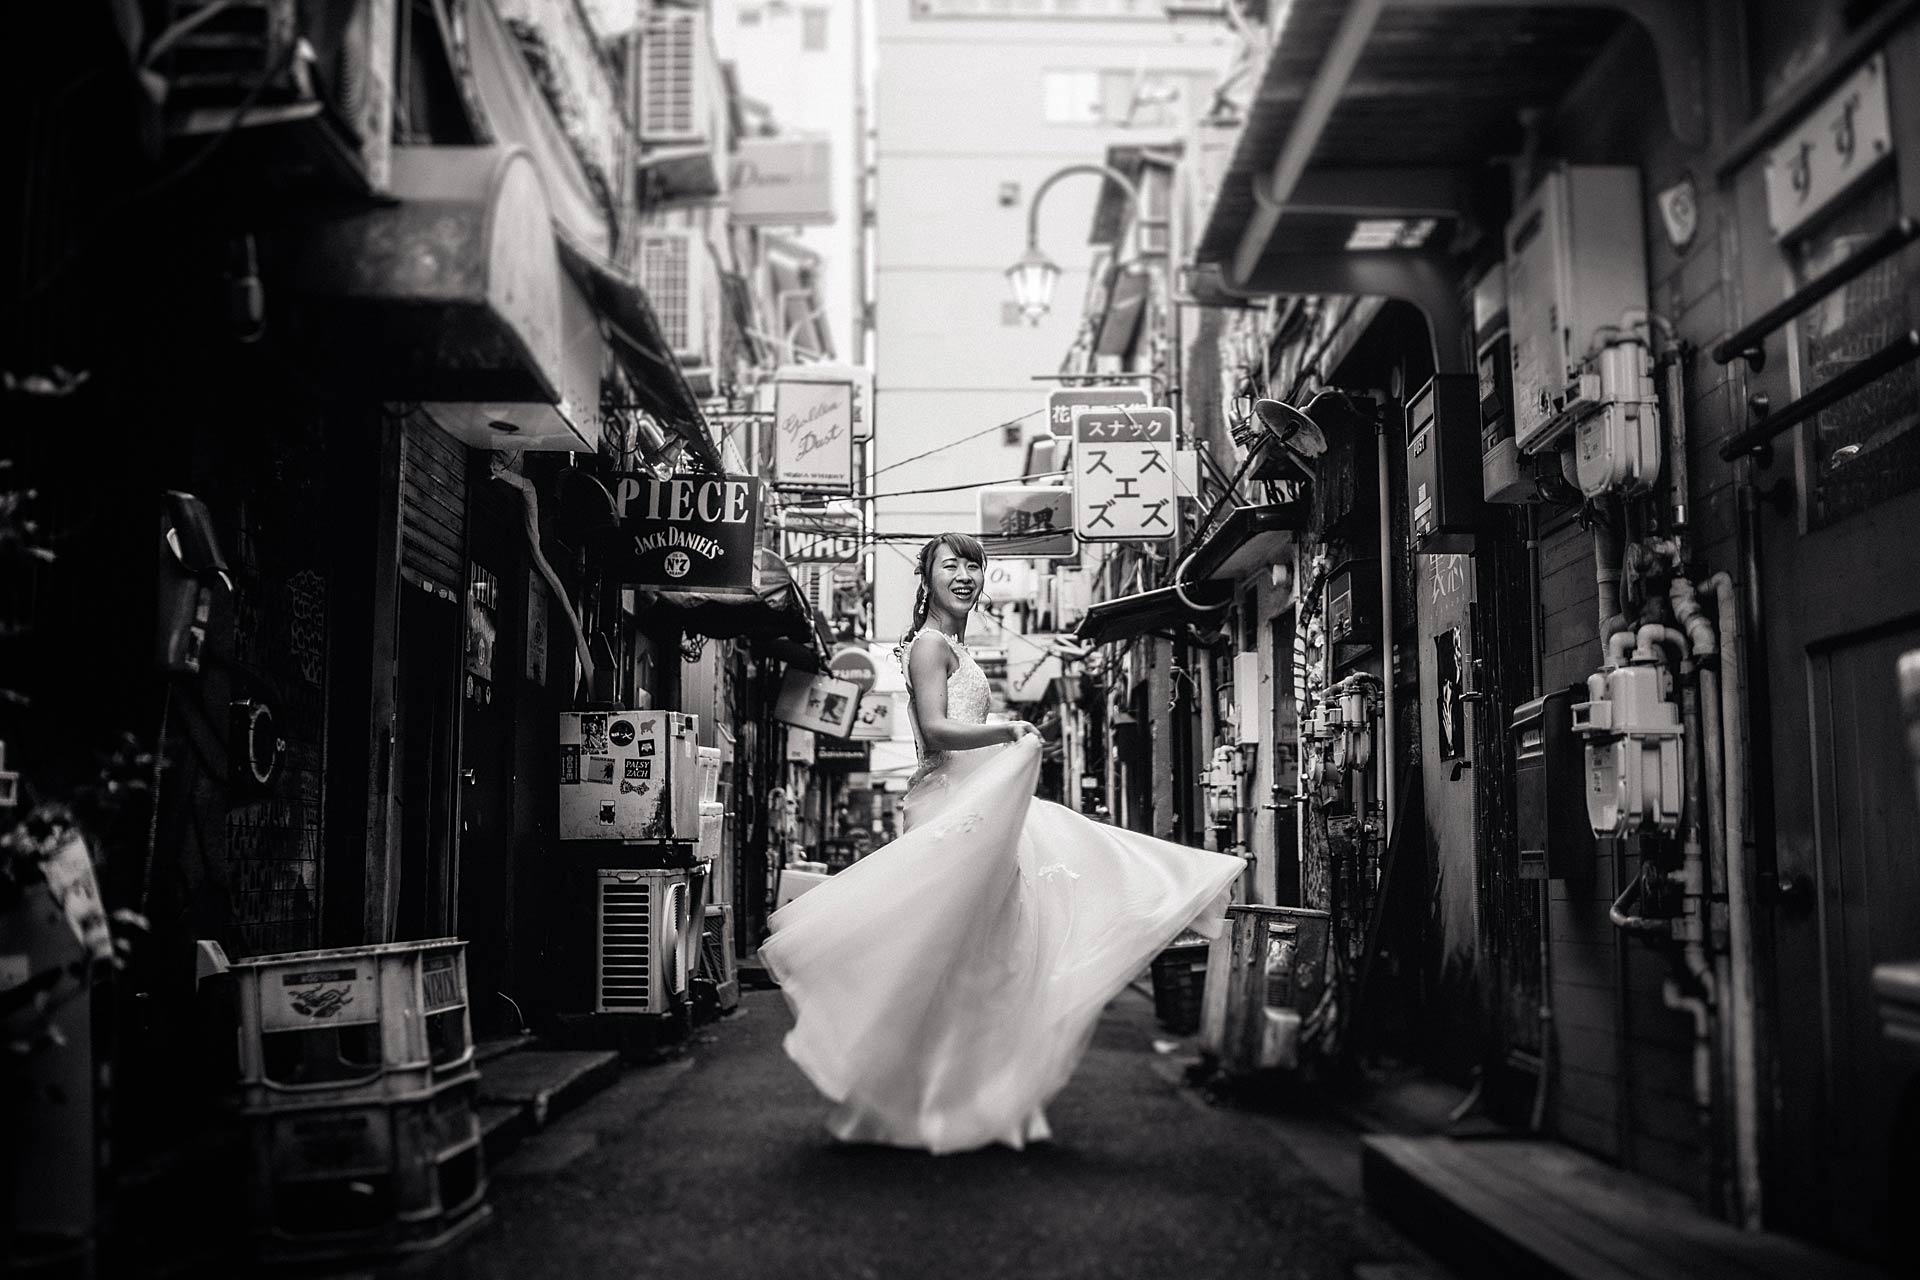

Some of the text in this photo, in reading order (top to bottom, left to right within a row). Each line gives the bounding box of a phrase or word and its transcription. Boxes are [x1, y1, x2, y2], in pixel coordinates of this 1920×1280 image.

[794, 423, 844, 462] Dust
[1088, 419, 1162, 437] スナック
[617, 478, 749, 524] PIECE
[634, 526, 720, 560] JACK DANIEL'S
[787, 531, 857, 558] WHO
[470, 560, 498, 611] PIECE
[626, 769, 648, 777] ZACH
[422, 969, 457, 1008] KIRIN
